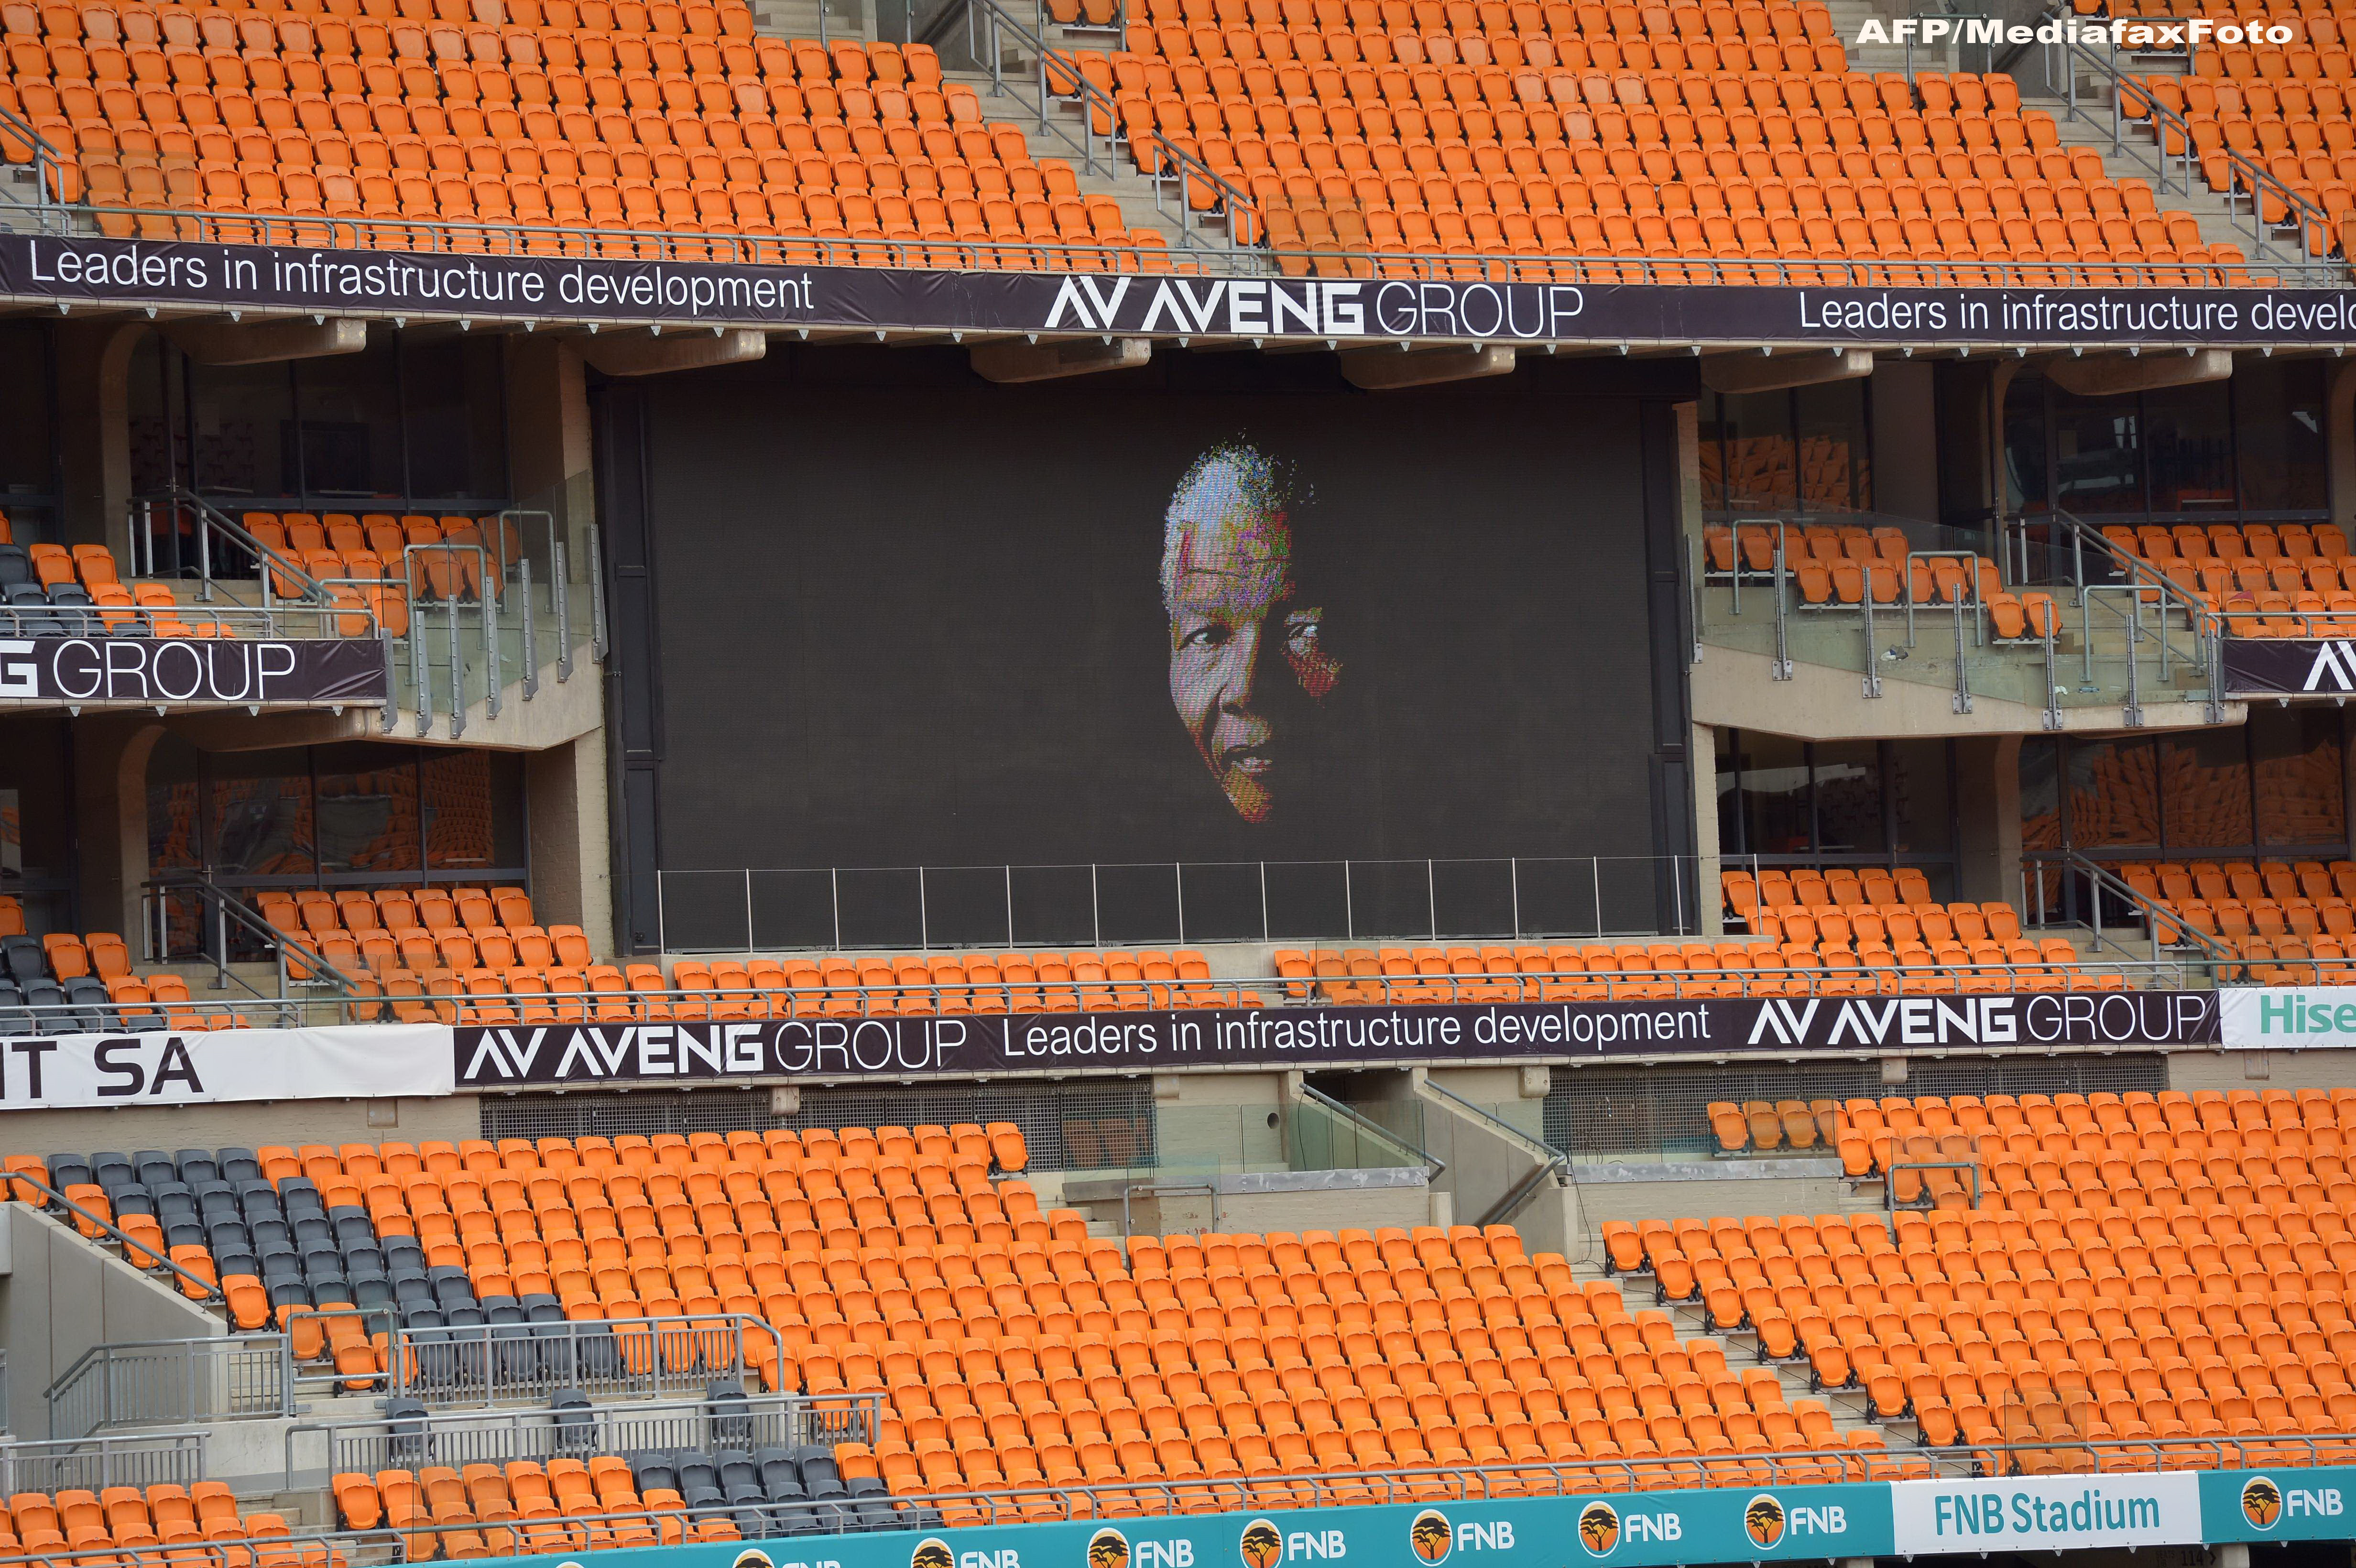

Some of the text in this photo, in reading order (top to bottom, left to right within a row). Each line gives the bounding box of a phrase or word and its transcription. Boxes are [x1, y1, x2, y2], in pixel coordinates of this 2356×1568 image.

[31, 239, 814, 315] Leaders in infrastructure development
[1045, 275, 1582, 337] AV AVENG GROUP
[1800, 292, 1946, 328] Leaders
[1961, 294, 1988, 328] in
[2004, 294, 2237, 330] infrastructure
[54, 640, 294, 699] GROUP
[1004, 1004, 1711, 1056] Leaders in infrastructure development
[1748, 995, 2205, 1044] AV AVENG GROUP
[2261, 995, 2356, 1033] Hise
[94, 1037, 204, 1096] SA
[464, 1021, 966, 1078] AV AVENG GROUP
[1790, 1506, 1846, 1535] FNB
[1935, 1490, 2160, 1535] FNB Stadium
[2287, 1489, 2343, 1516] FNB
[1288, 1531, 1346, 1560] FNB
[1458, 1522, 1515, 1551] FNB
[1625, 1514, 1681, 1542] FNB
[1136, 1539, 1194, 1568] FNB
